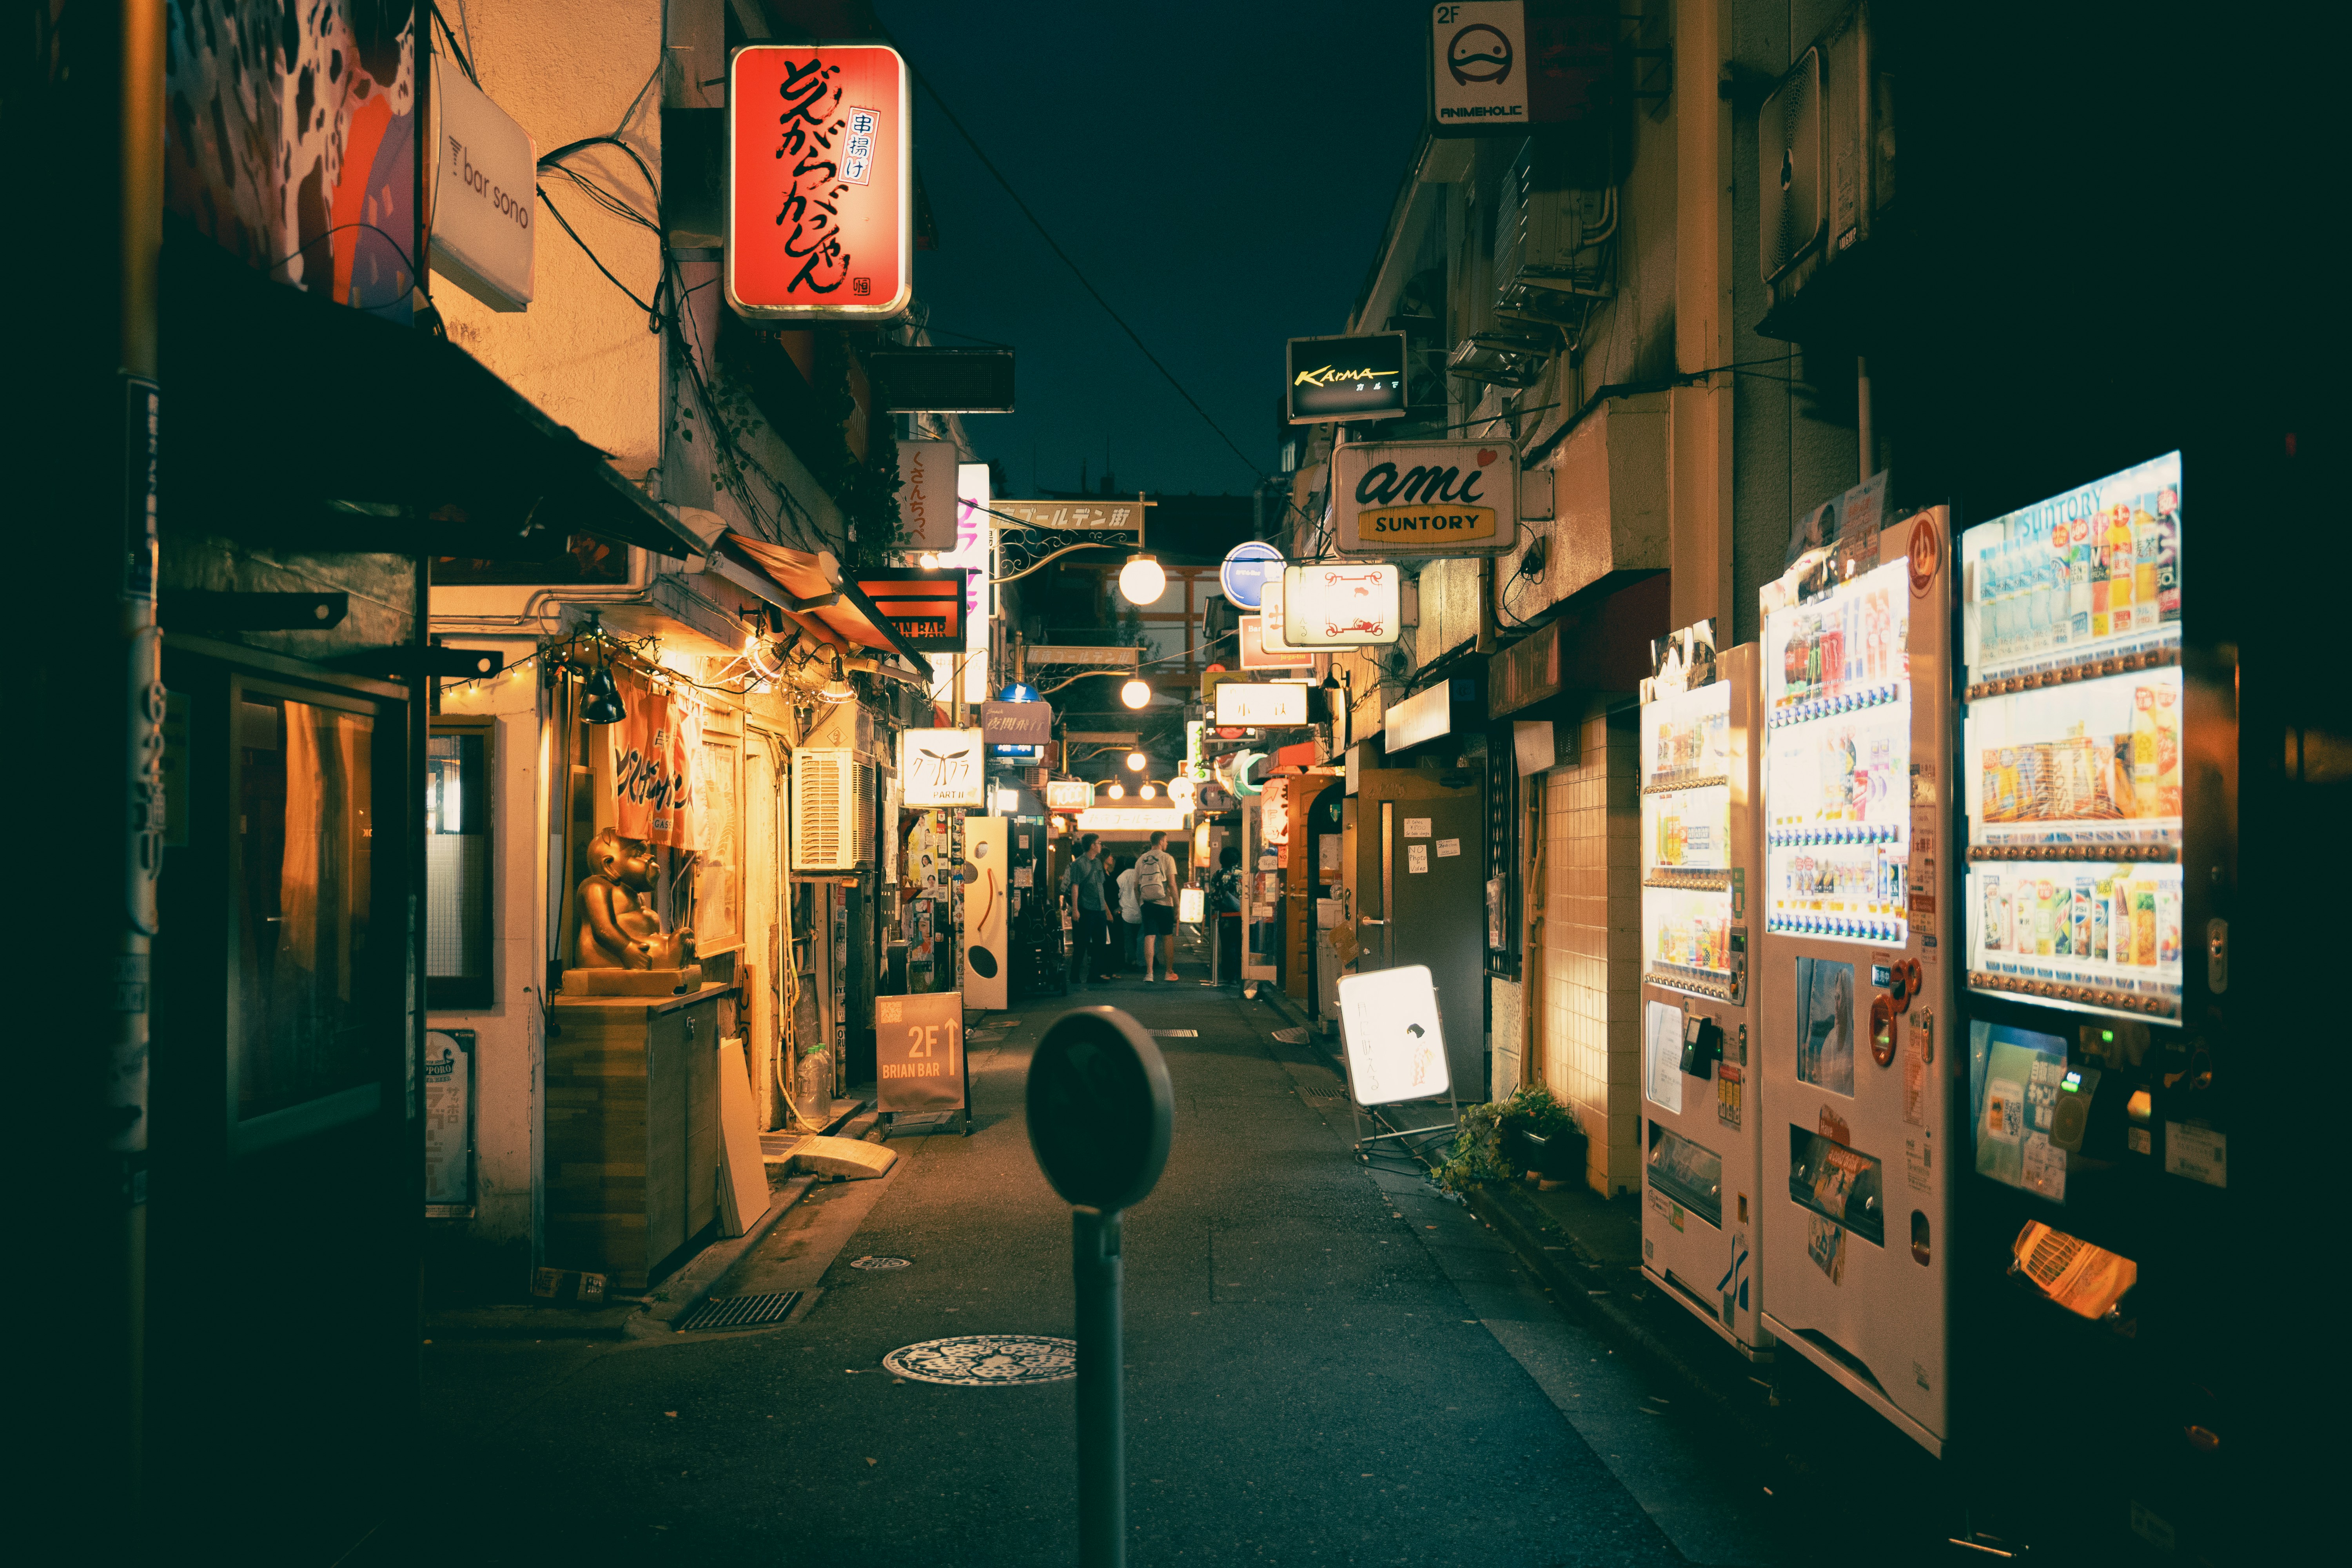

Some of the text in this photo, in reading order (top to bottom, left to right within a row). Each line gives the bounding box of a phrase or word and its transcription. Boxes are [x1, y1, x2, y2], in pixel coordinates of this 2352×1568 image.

[1437, 6, 1460, 24] 2F
[1441, 105, 1522, 118] ANIMEHOLIC
[844, 114, 874, 178] 串揚げ
[464, 159, 528, 229] bar sono
[1356, 381, 1399, 391] カルマ
[1355, 462, 1484, 504] ami
[1376, 515, 1479, 532] SUNTORY
[918, 622, 946, 637] BAR
[987, 717, 1044, 731] 夜間飛行
[911, 758, 969, 786] クラクラ
[909, 1025, 939, 1058] 2F
[883, 1062, 940, 1079] BRIAN BAR
[447, 1087, 459, 1124] サッポロ
[1820, 1120, 1833, 1138] Have
